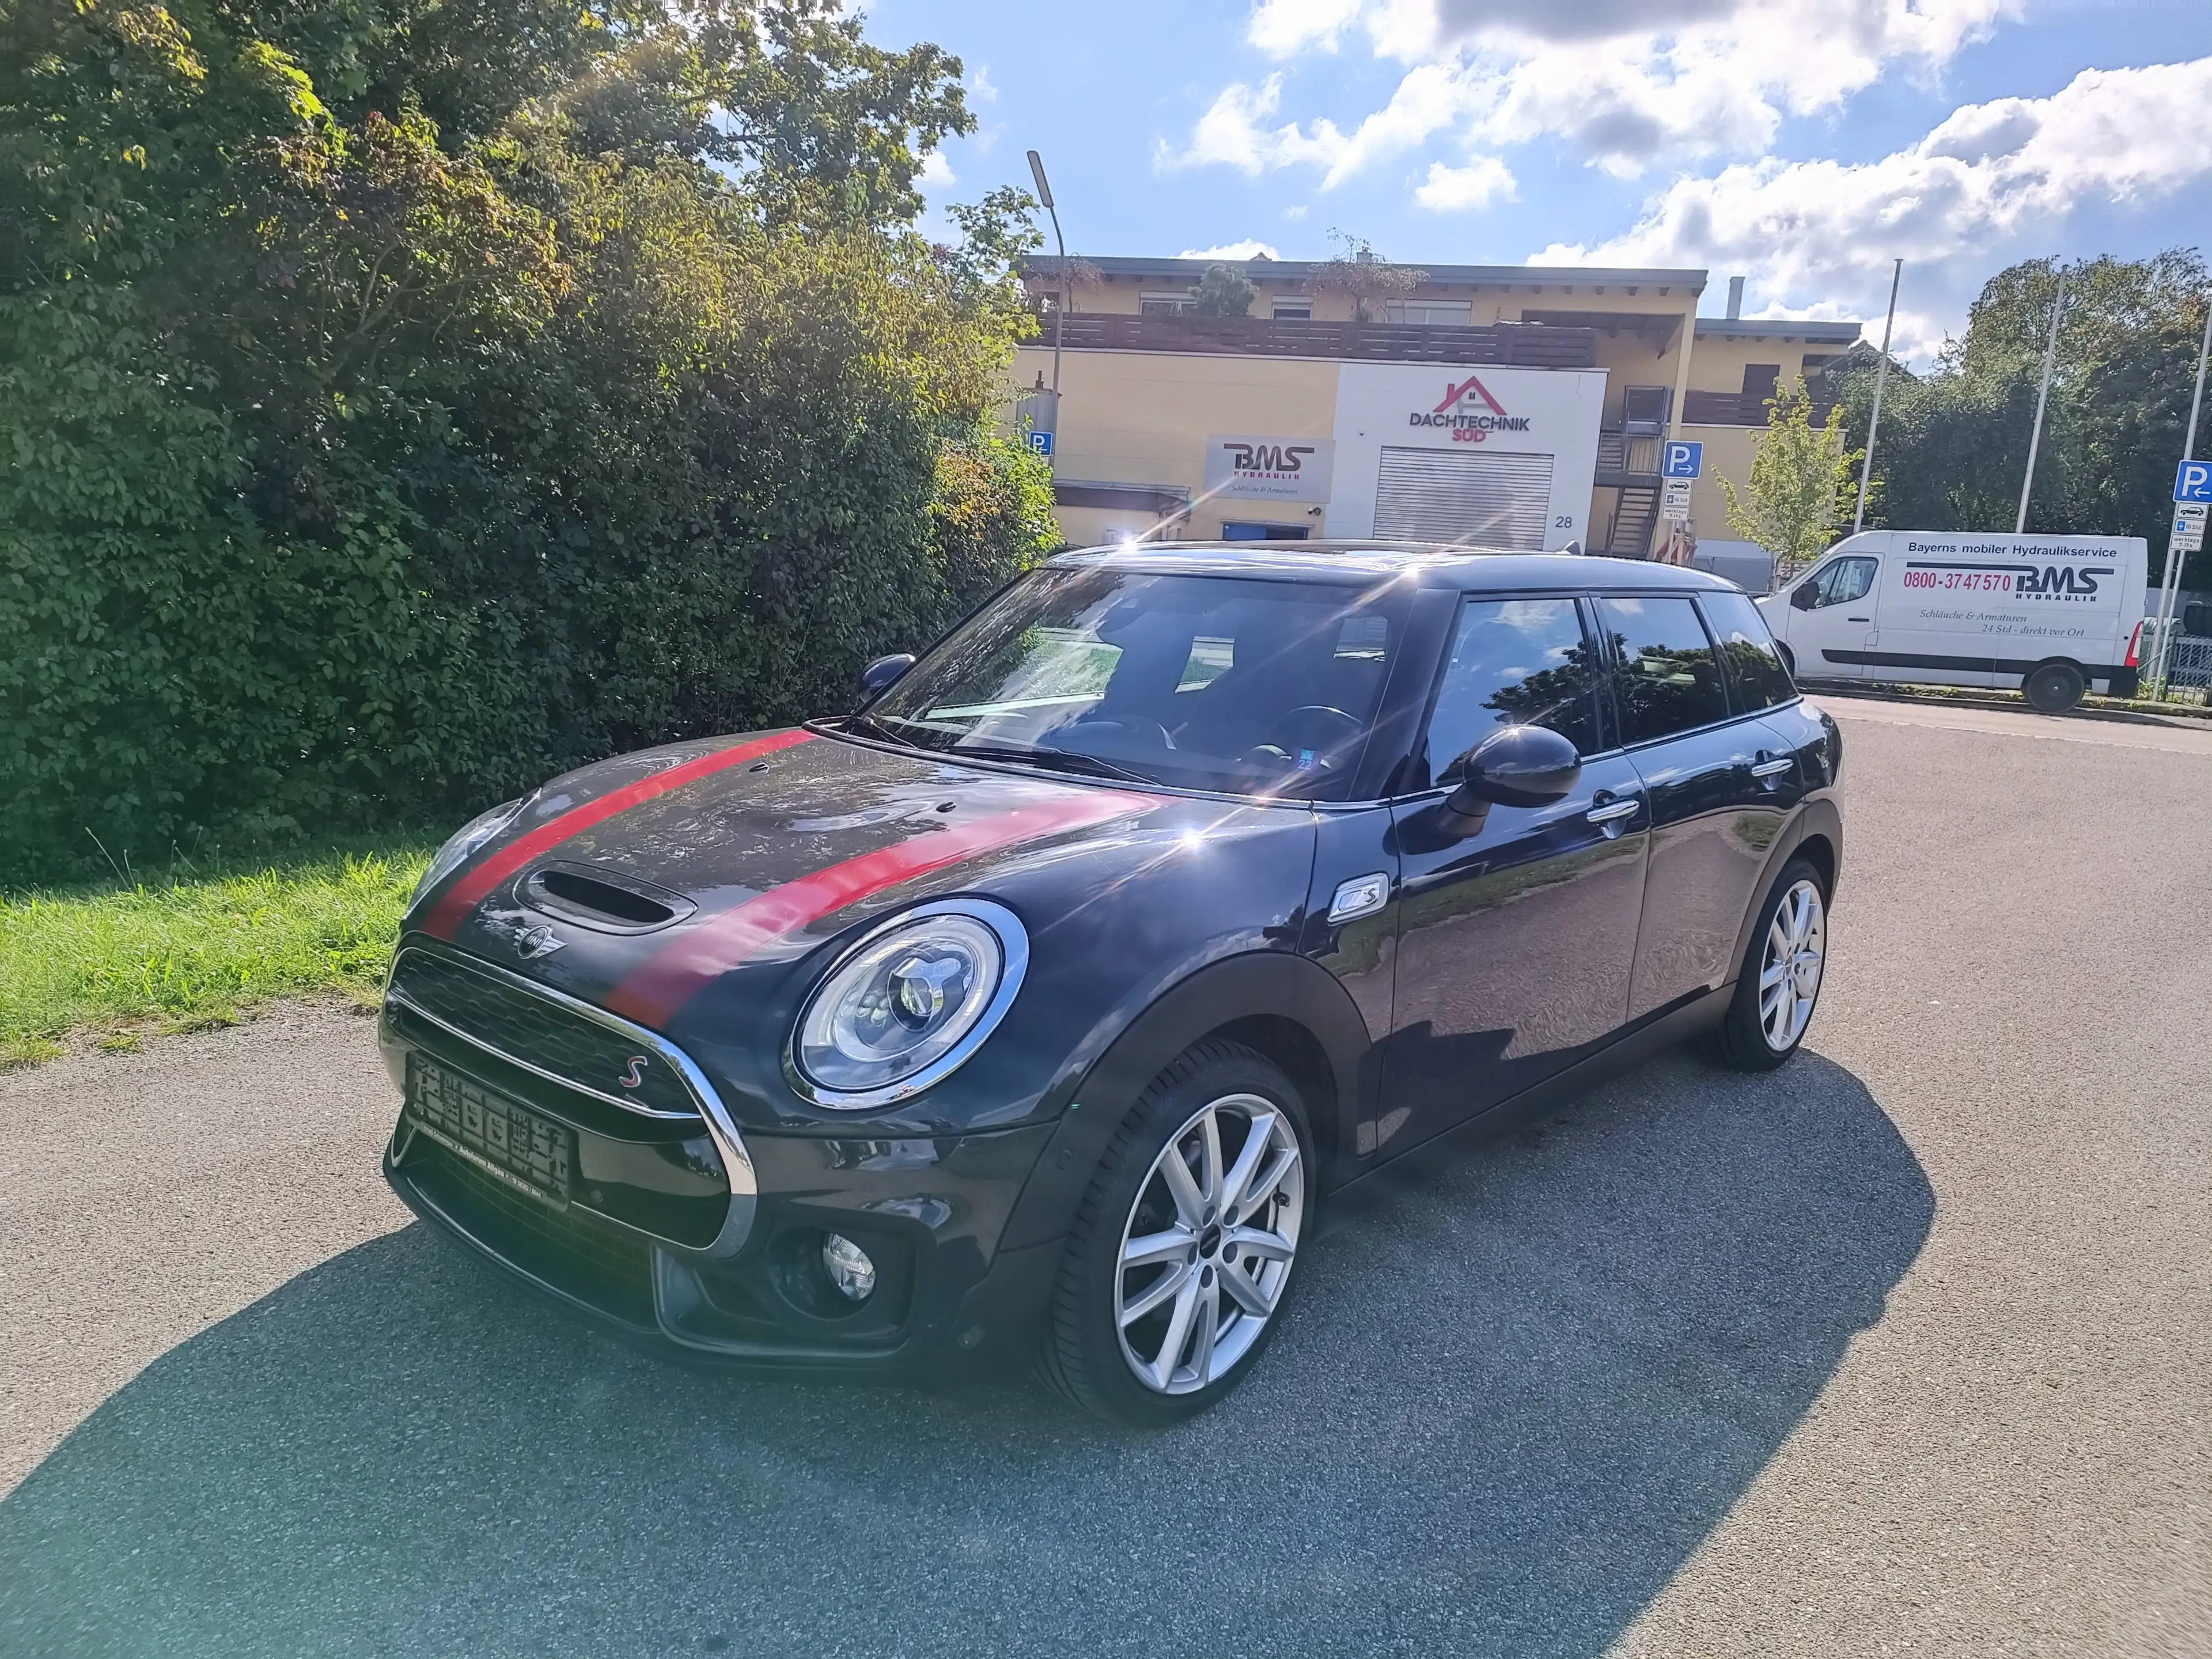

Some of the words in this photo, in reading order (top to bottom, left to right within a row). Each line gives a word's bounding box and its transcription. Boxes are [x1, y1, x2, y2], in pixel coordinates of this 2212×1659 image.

[1410, 412, 1530, 431] DACHTECHNIK
[1452, 428, 1486, 442] SÜD
[1033, 435, 1045, 452] P
[1224, 443, 1315, 472] BMS
[1669, 446, 1691, 473] P
[1234, 471, 1300, 480] HYDRAULIK
[2181, 466, 2208, 497] P
[1555, 516, 1572, 528] 28
[1908, 542, 1957, 554] Bayerns
[1962, 544, 2008, 554] mobiler
[2013, 545, 2117, 557] Hydraulikservice
[2016, 565, 2114, 594] BMS
[2016, 593, 2097, 602] HYDRAULIK
[1919, 609, 1963, 620] Schläuche
[1976, 612, 2027, 622] Armaturen
[1982, 624, 1993, 632] 24
[1996, 624, 2012, 634] Std
[2020, 626, 2047, 635] direkt
[2067, 628, 2084, 637] Ort
[618, 1055, 648, 1088] S
